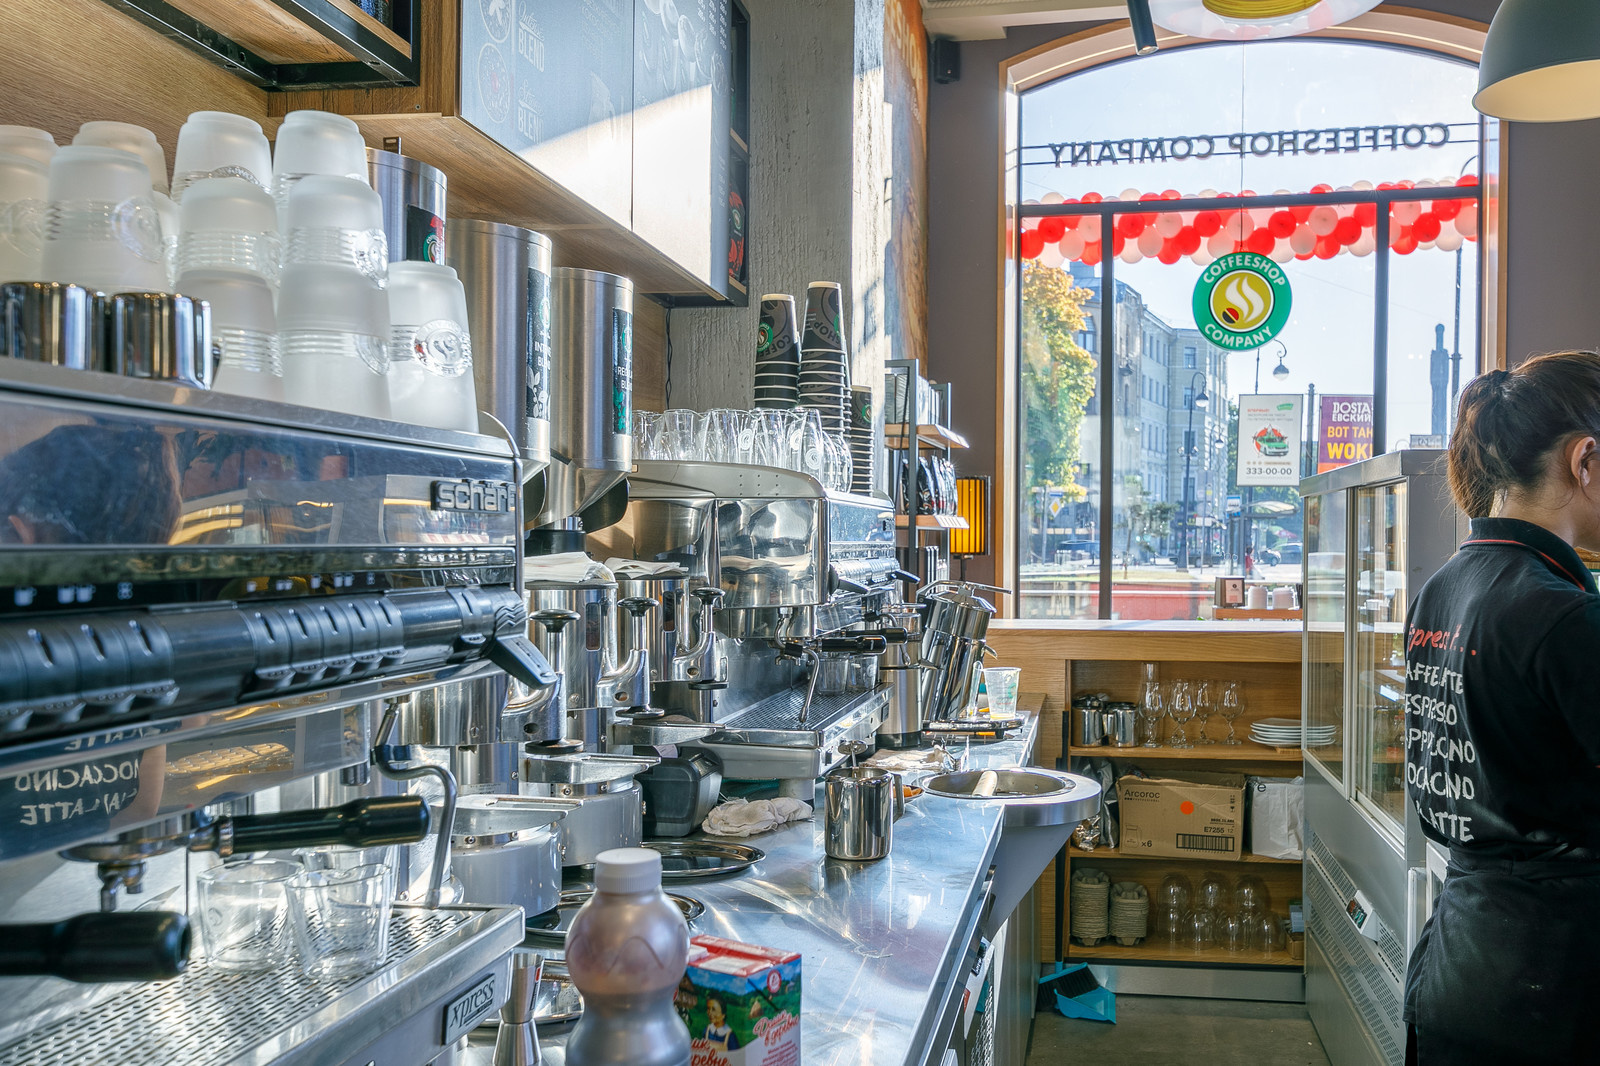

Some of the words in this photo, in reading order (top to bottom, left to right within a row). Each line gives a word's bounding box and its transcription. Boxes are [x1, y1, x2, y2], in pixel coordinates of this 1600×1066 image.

[518, 27, 545, 73] BLEND
[1203, 255, 1286, 286] COFFEESHOP
[1204, 323, 1273, 347] COMPANY
[1246, 467, 1292, 475] 333-00-00
[1124, 789, 1160, 799] Arcoroc
